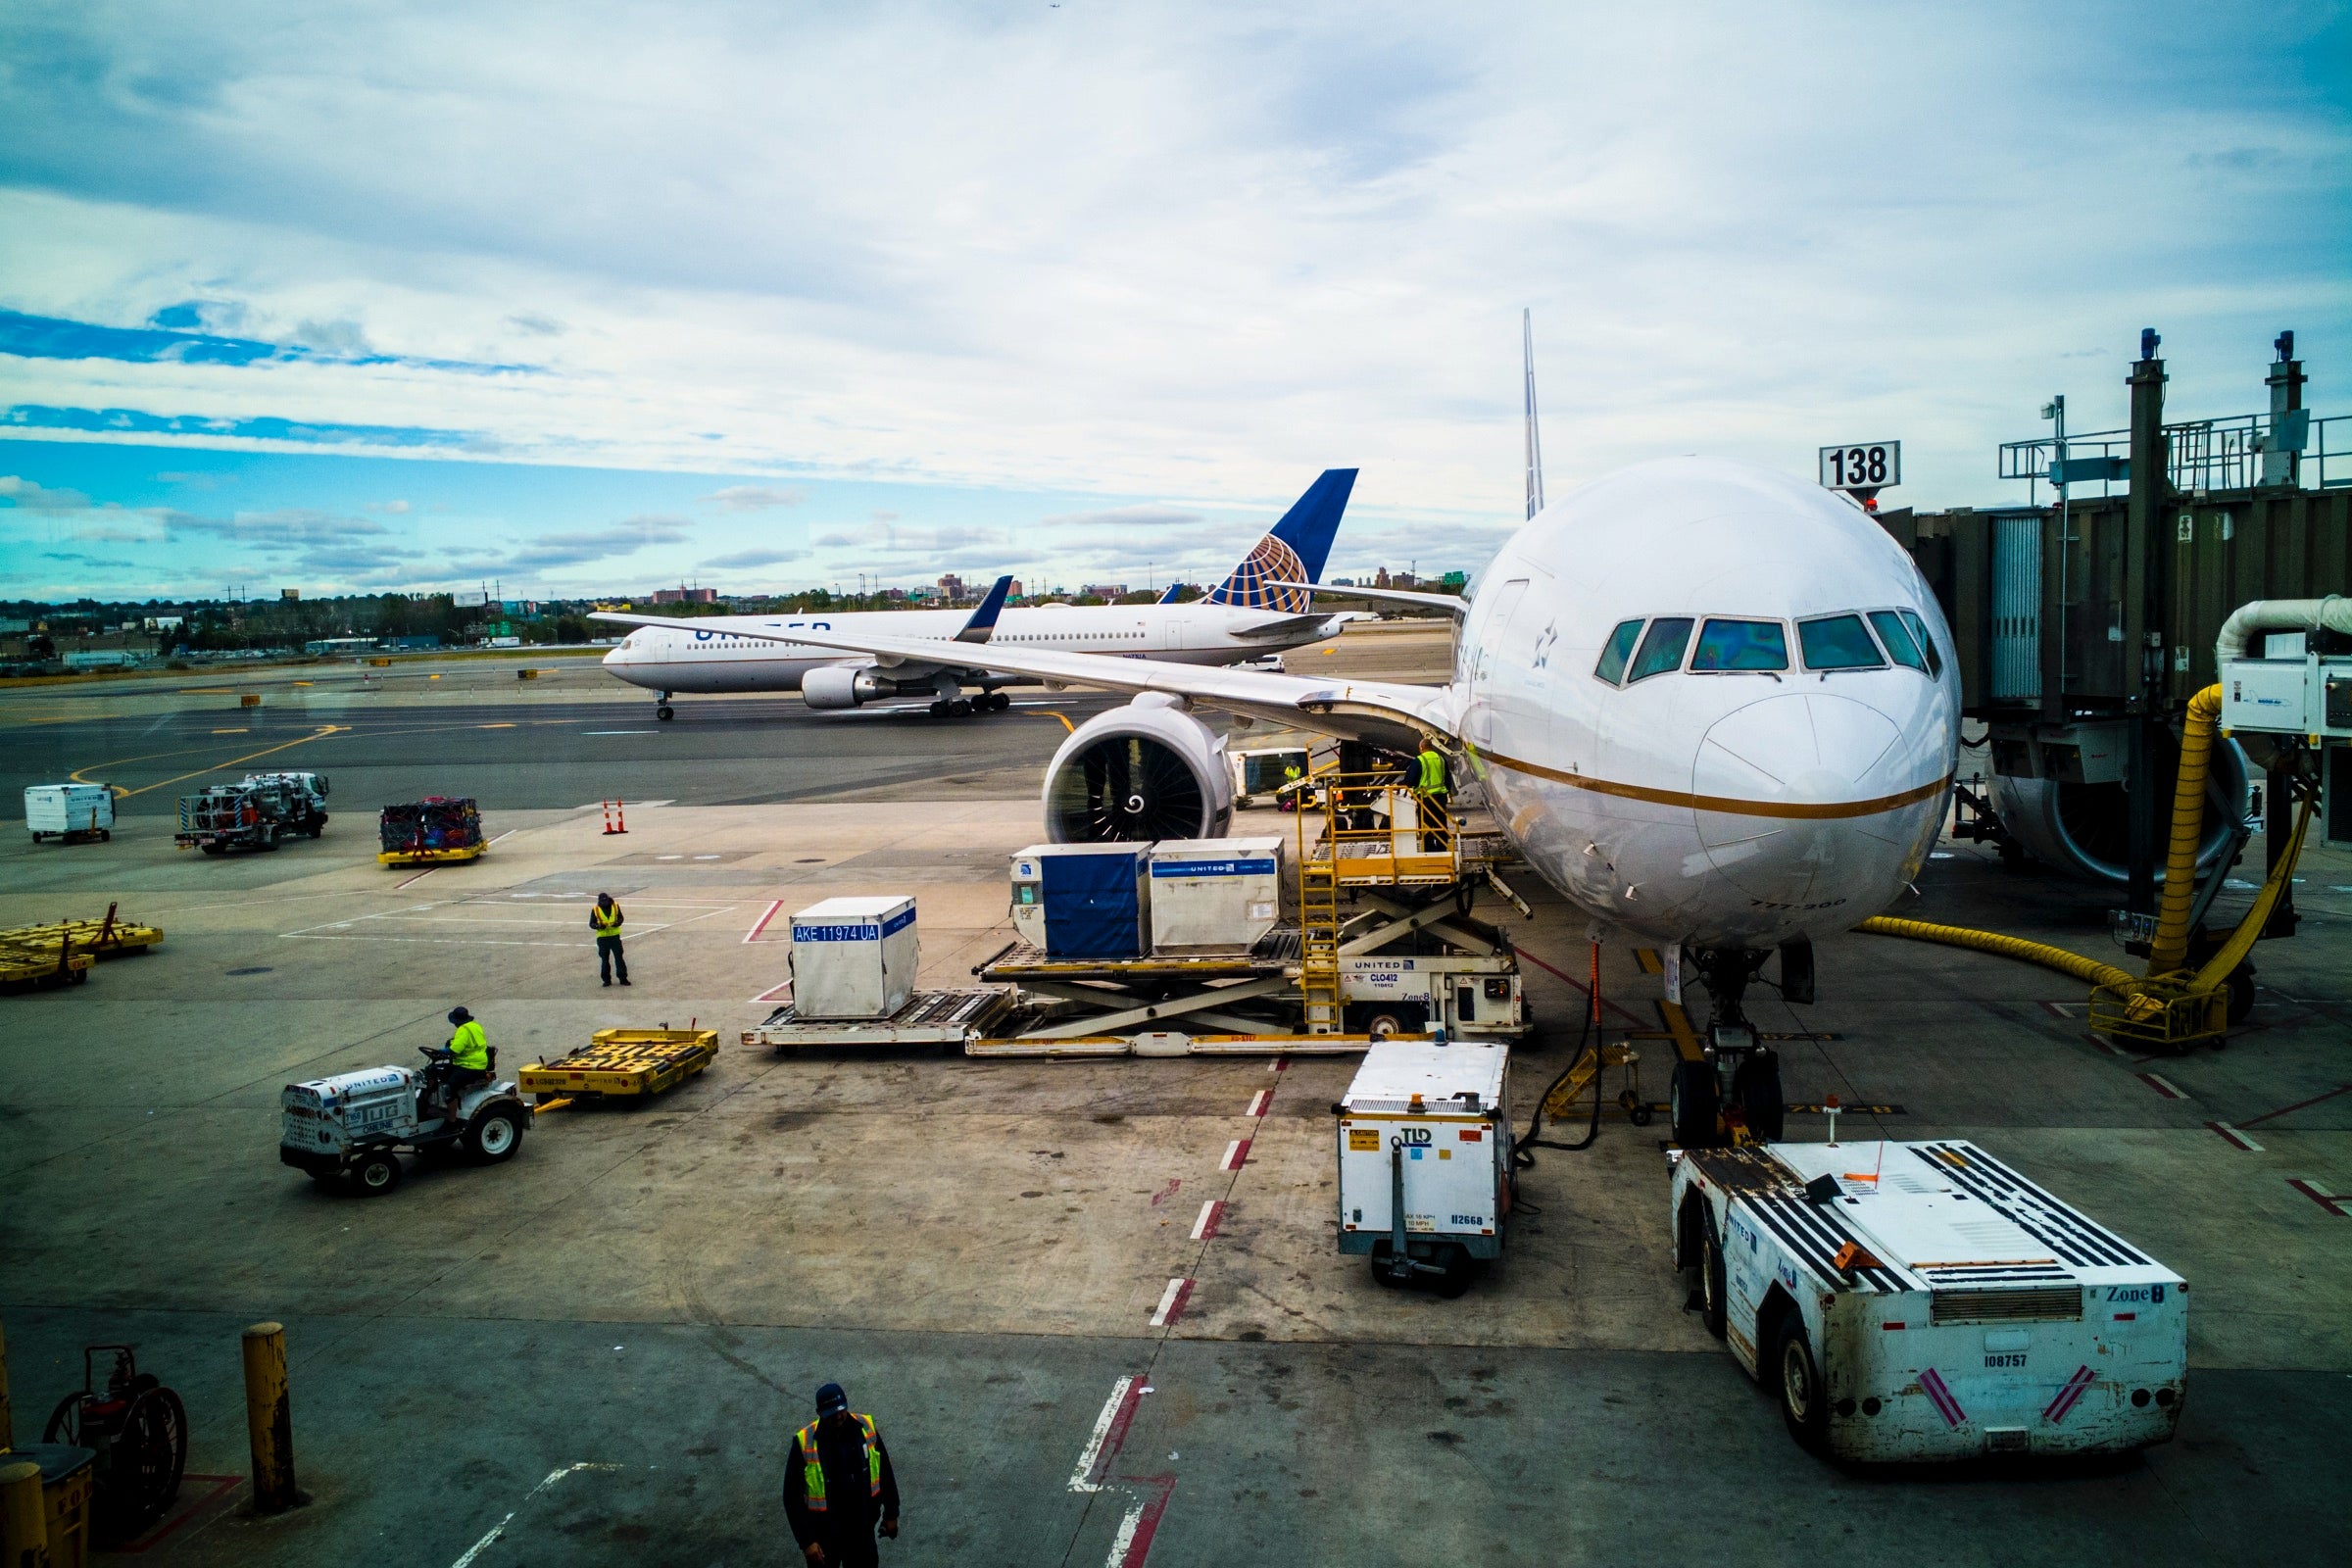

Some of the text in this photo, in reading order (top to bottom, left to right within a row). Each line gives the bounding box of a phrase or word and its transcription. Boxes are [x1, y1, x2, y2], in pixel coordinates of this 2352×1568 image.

[1830, 446, 1886, 485] 138
[1750, 899, 1847, 910] 777-200
[796, 925, 876, 941] AKE 11974 UA
[346, 1077, 387, 1091] UNITED
[1401, 1128, 1432, 1144] TLD
[1451, 1214, 1483, 1225] 112668
[1984, 1354, 2027, 1367] 108757
[57, 1481, 93, 1515] FOD
